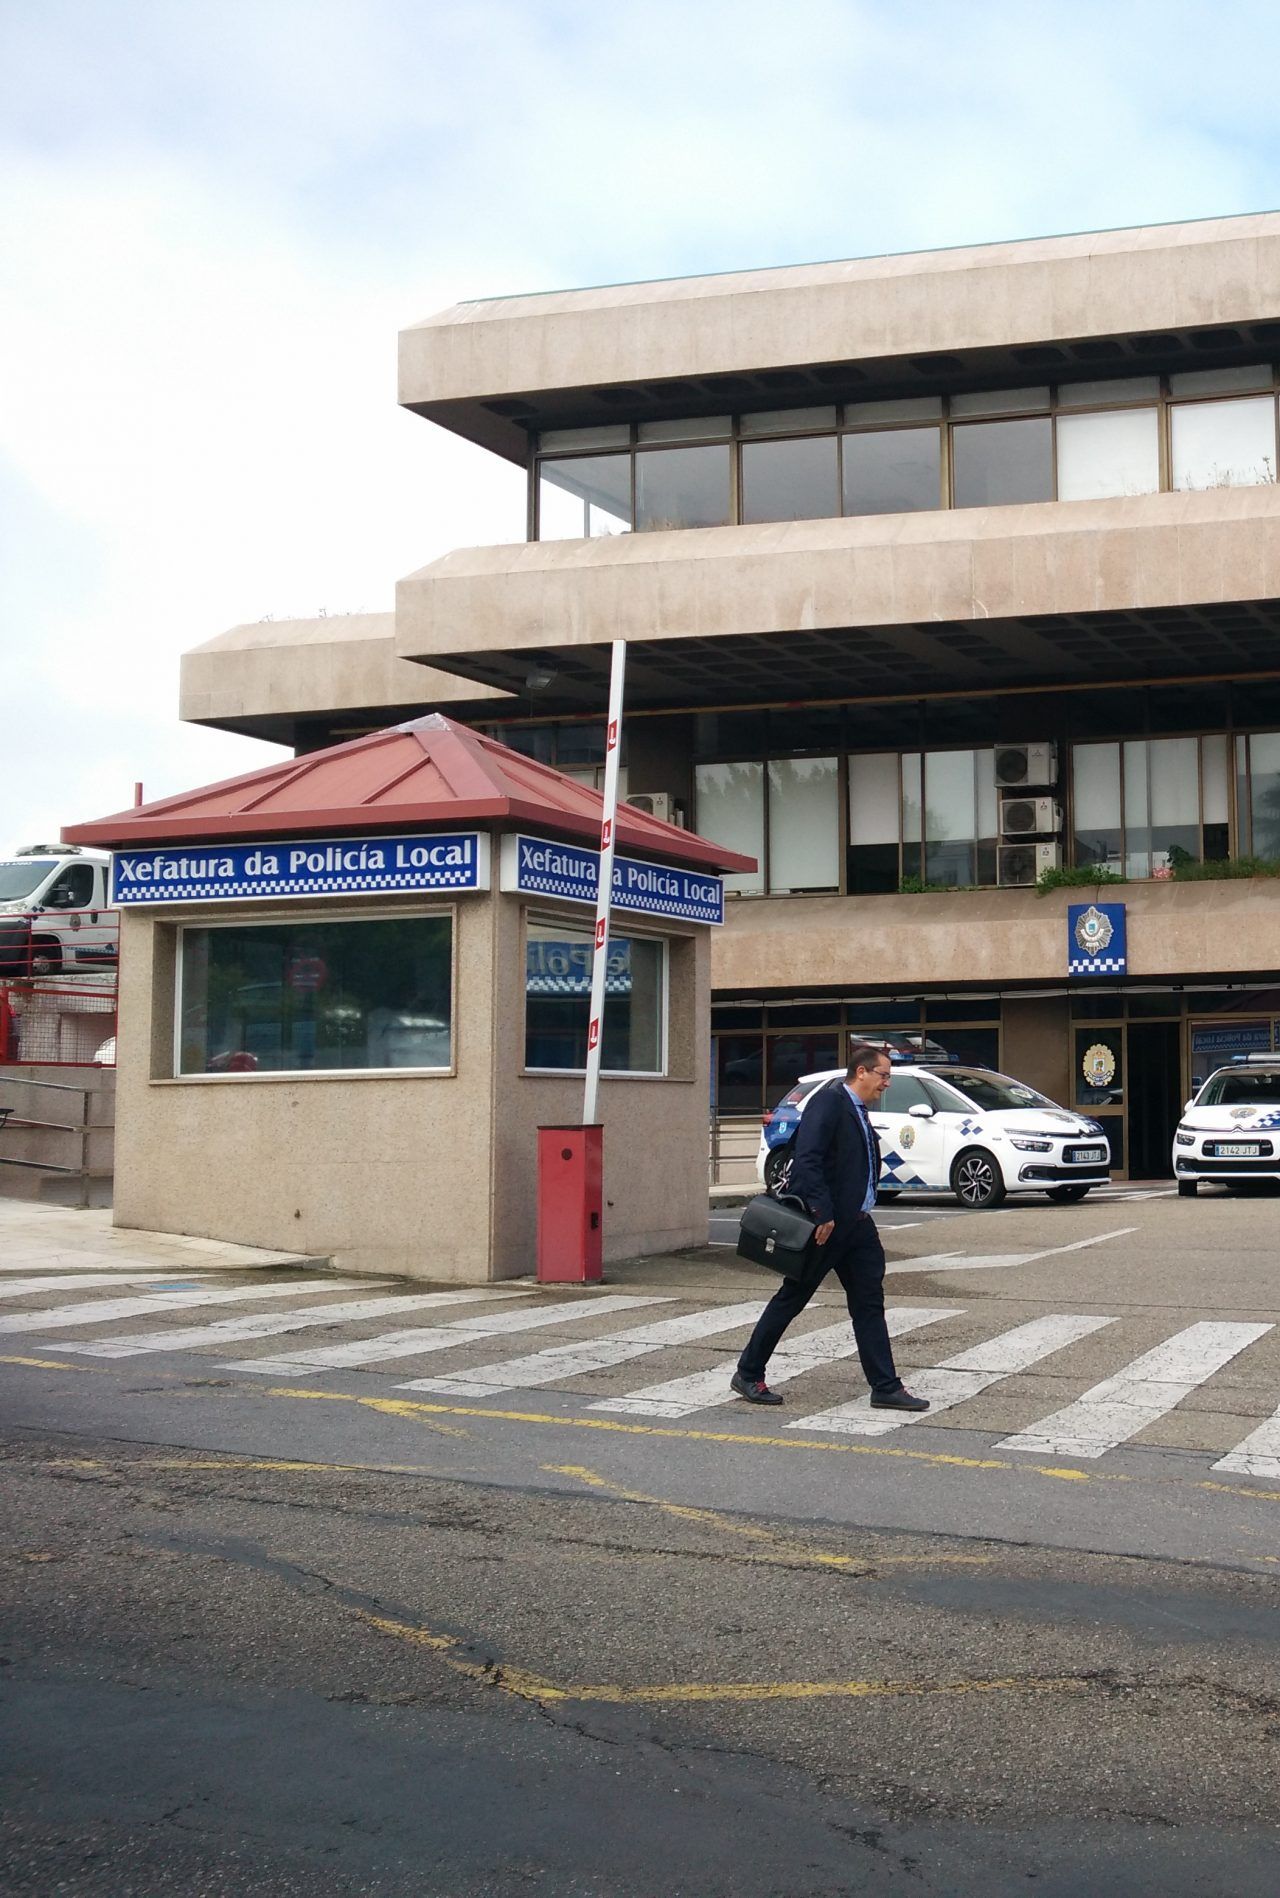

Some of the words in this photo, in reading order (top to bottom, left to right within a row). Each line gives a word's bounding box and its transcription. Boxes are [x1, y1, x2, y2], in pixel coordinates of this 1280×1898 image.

[119, 855, 234, 882] Xefatura
[245, 851, 279, 876] da
[289, 843, 385, 873] Policía
[397, 839, 471, 868] Local
[521, 846, 596, 881] Xefatura
[628, 867, 679, 897] Policía
[684, 878, 720, 905] Local
[1220, 1147, 1240, 1155] 2142
[1242, 1147, 1257, 1155] JTJ
